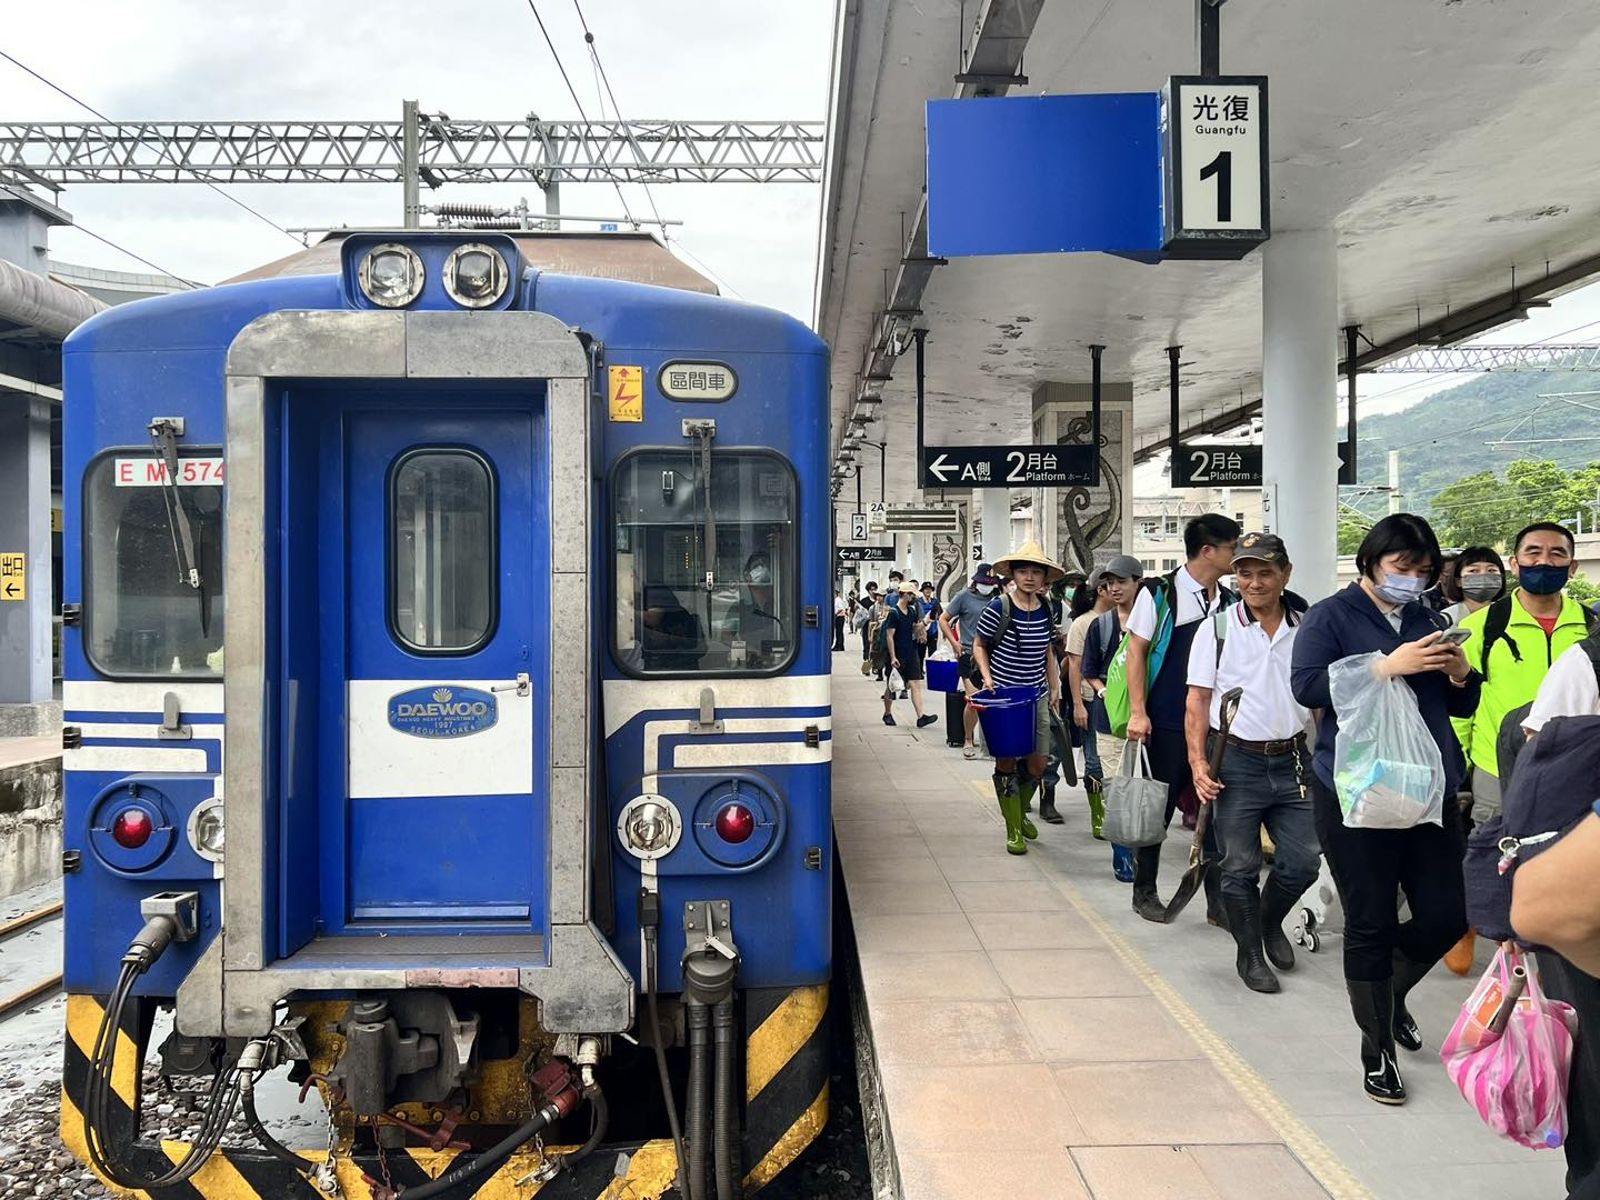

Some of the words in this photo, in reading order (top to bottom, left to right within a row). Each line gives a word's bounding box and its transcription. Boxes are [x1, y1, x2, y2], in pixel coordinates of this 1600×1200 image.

[1193, 95, 1249, 121] 光復
[1195, 125, 1246, 136] Guangfu
[1200, 151, 1231, 222] 1
[669, 371, 726, 391] 區間車
[1026, 471, 1066, 482] Platform
[1210, 471, 1250, 482] Platform
[871, 503, 885, 512] 2A
[855, 525, 864, 538] 2
[2, 556, 23, 576] 出口
[397, 702, 488, 717] DAEWOO
